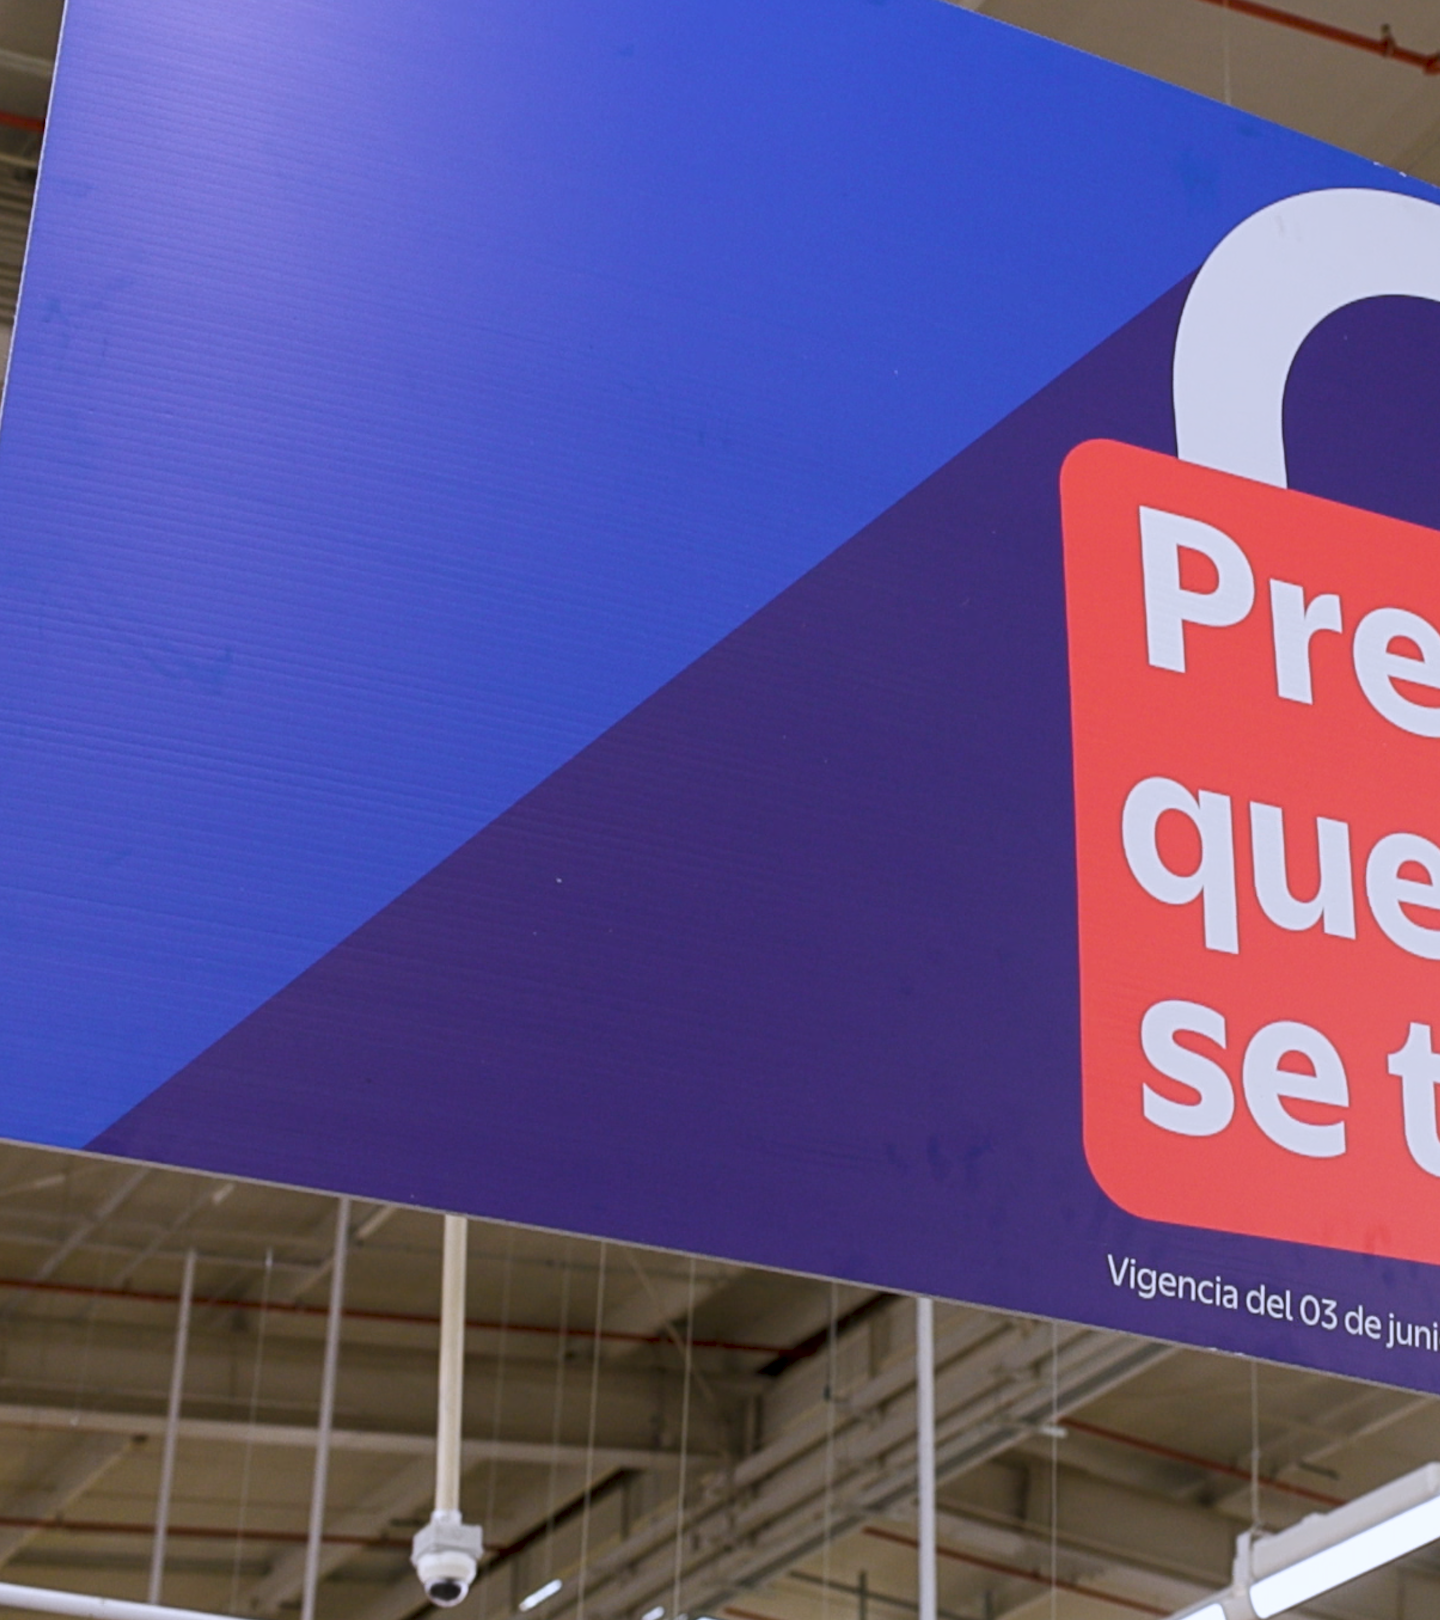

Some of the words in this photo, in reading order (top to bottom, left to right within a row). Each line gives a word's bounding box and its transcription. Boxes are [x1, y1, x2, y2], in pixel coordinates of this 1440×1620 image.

[1140, 999, 1350, 1158] se
[1107, 1254, 1239, 1310] Vigencia
[1246, 1284, 1294, 1321] del
[1299, 1294, 1339, 1330] 03
[1344, 1304, 1382, 1340] de
